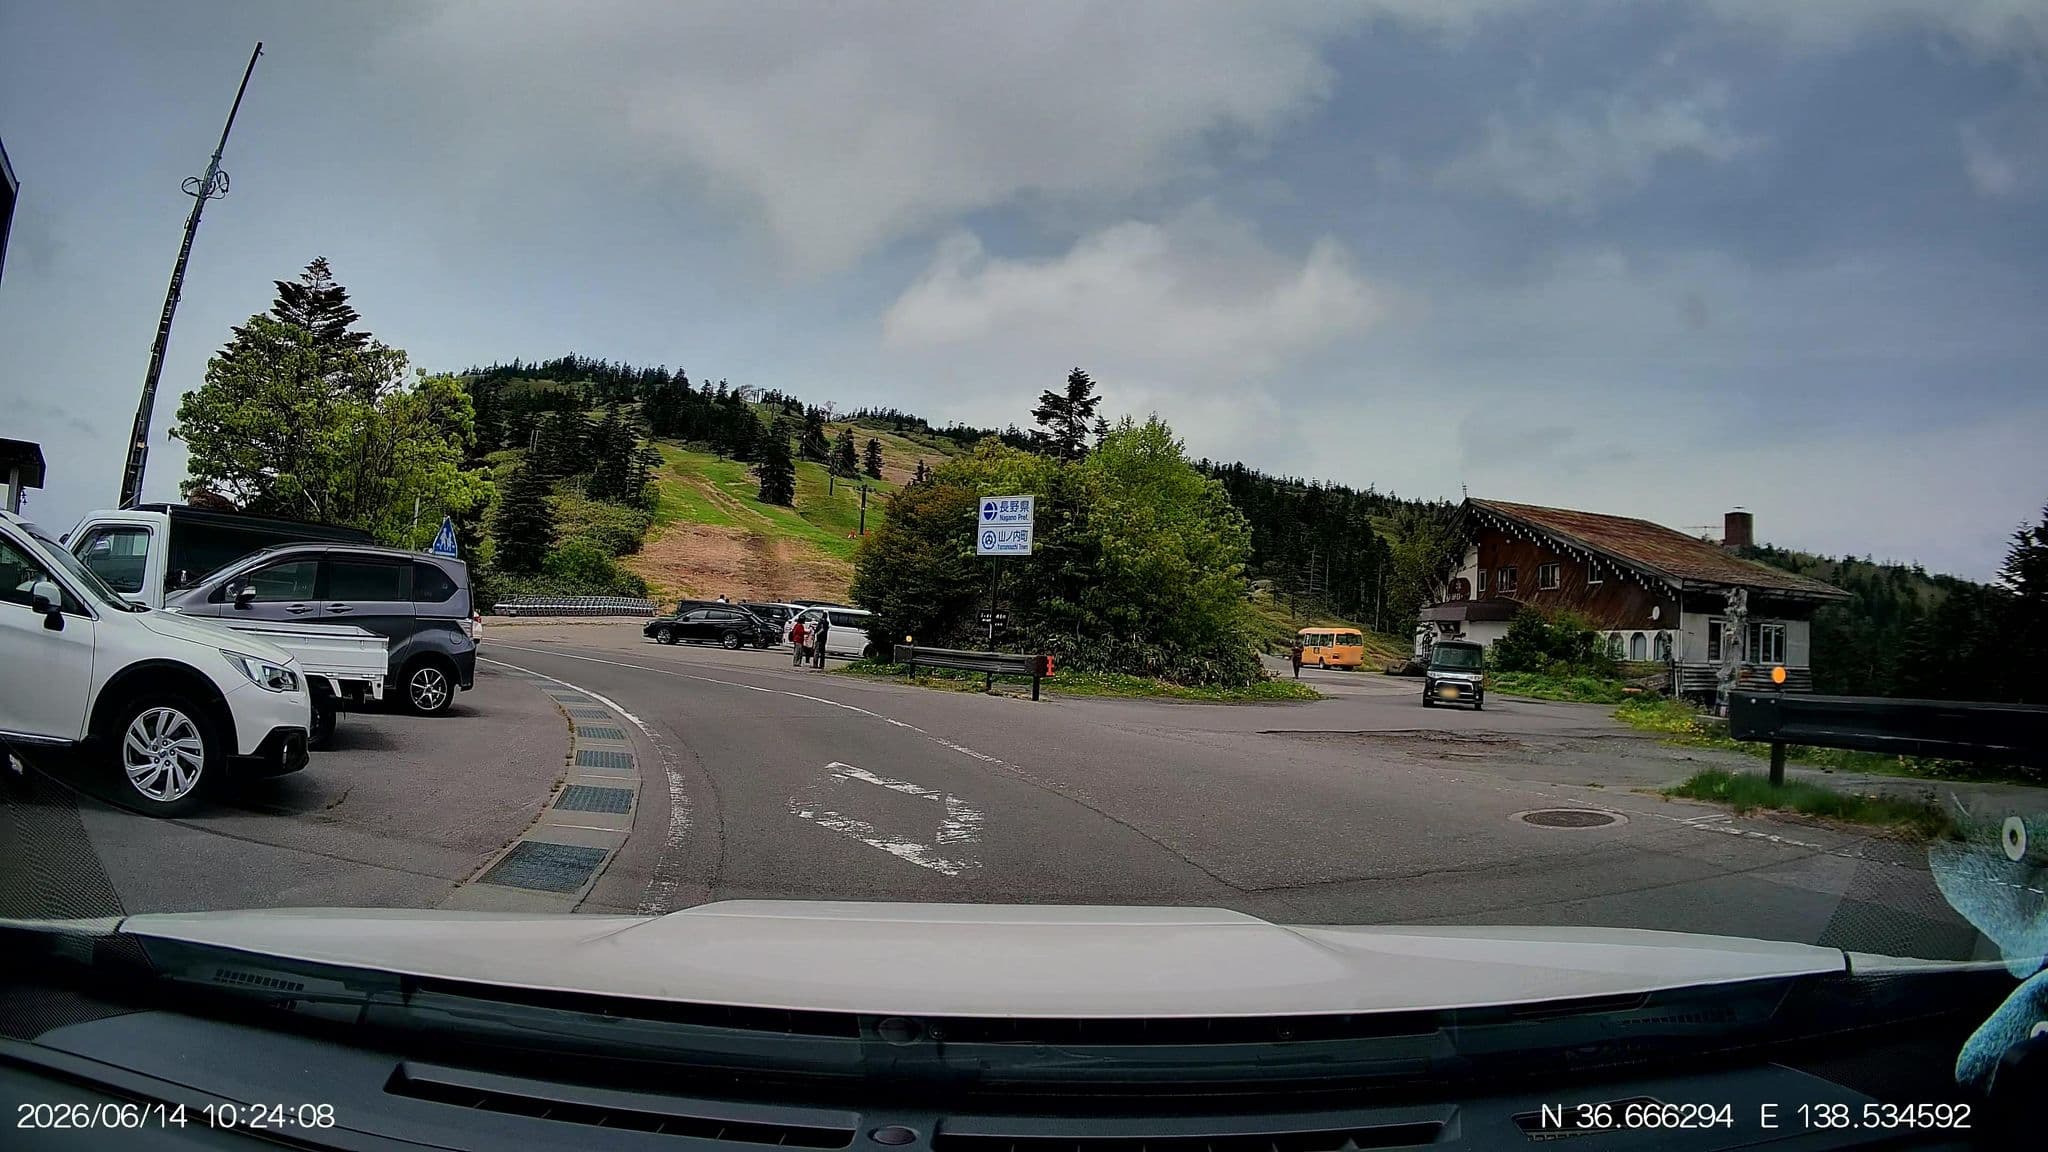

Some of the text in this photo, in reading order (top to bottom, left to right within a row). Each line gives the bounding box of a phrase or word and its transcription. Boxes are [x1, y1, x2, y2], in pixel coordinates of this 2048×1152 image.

[999, 501, 1029, 512] 長野県
[998, 530, 1029, 542] 山ノ内町
